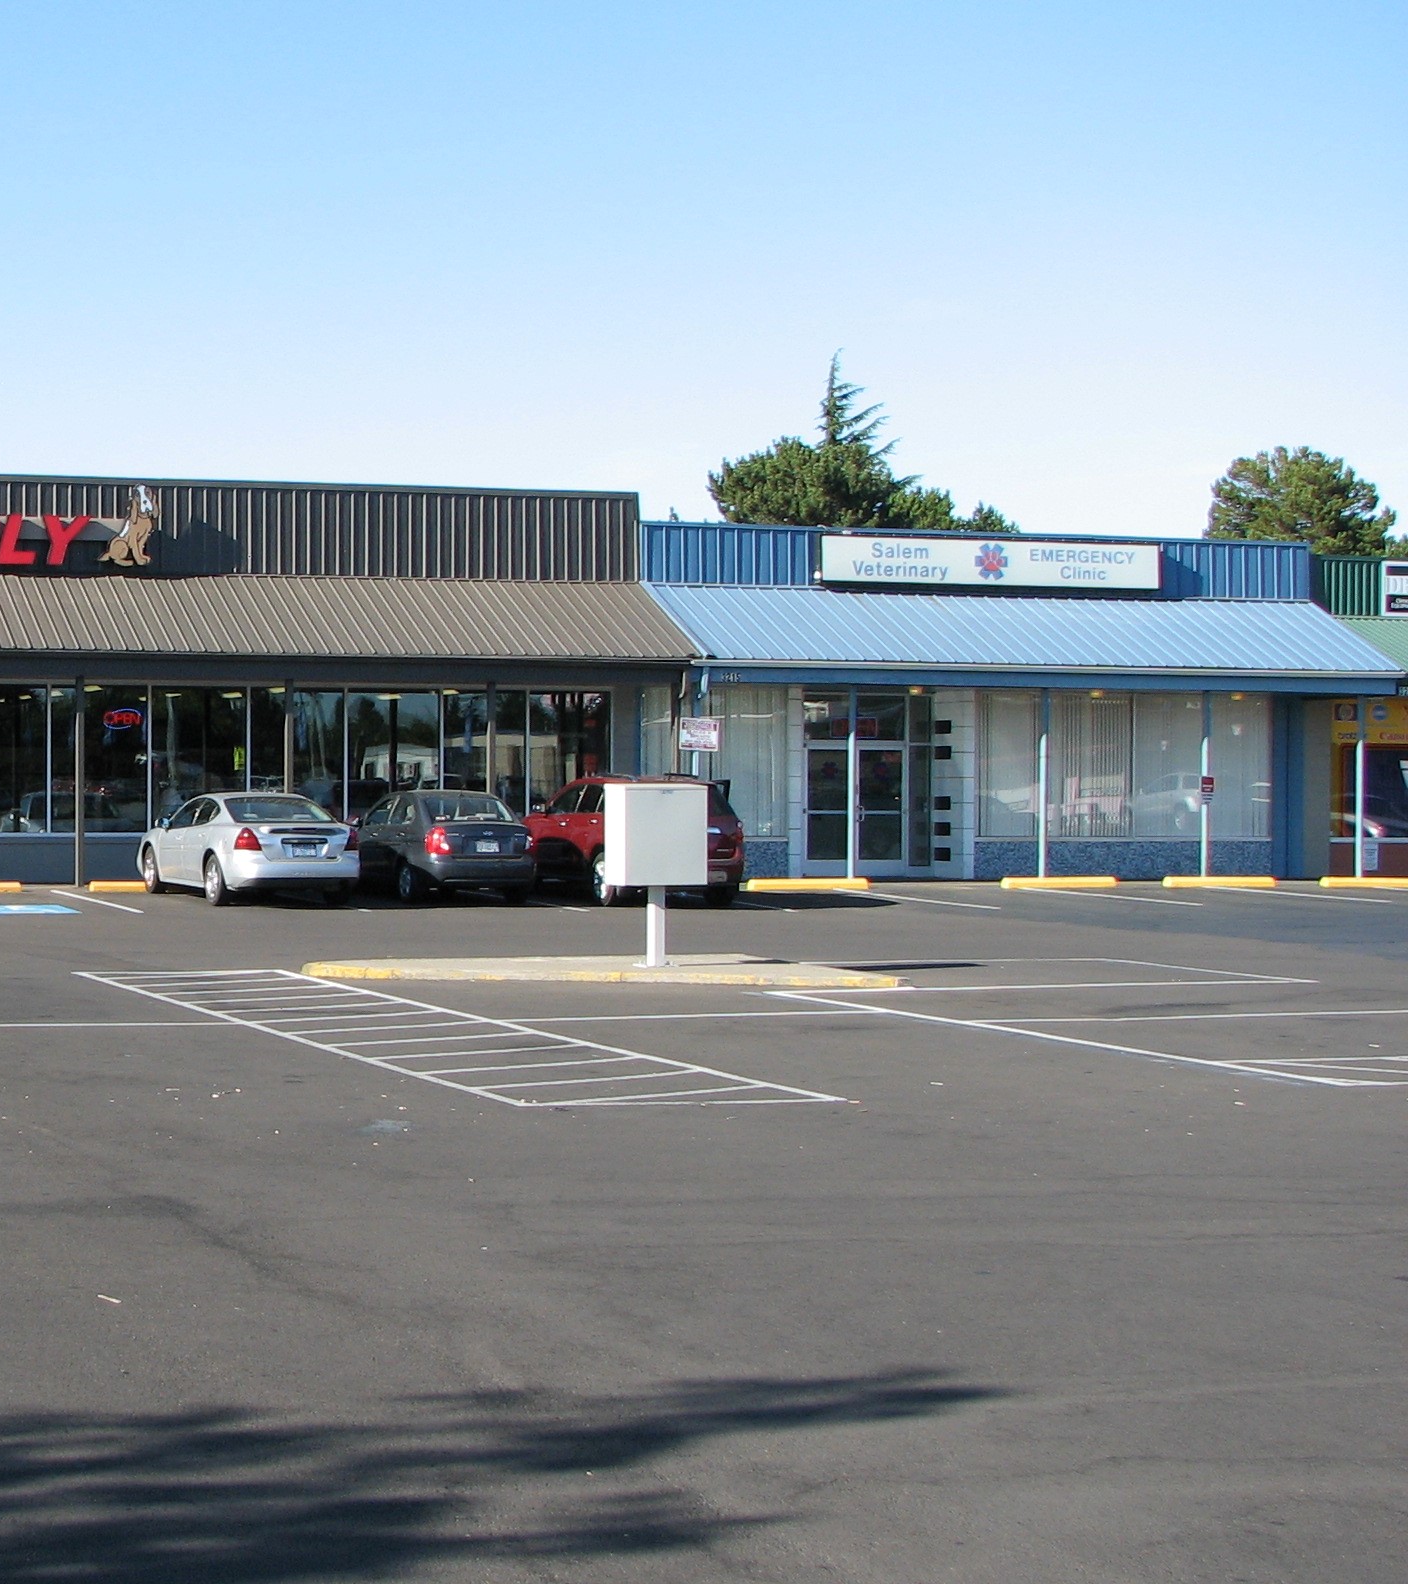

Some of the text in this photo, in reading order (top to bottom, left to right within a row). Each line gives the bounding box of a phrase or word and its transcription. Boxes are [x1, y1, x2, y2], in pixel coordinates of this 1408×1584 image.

[871, 542, 930, 559] Salem
[1029, 548, 1136, 565] EMERGENCY
[852, 560, 949, 581] Veterinary
[1059, 565, 1107, 580] Clinic
[103, 710, 142, 726] OPEN
